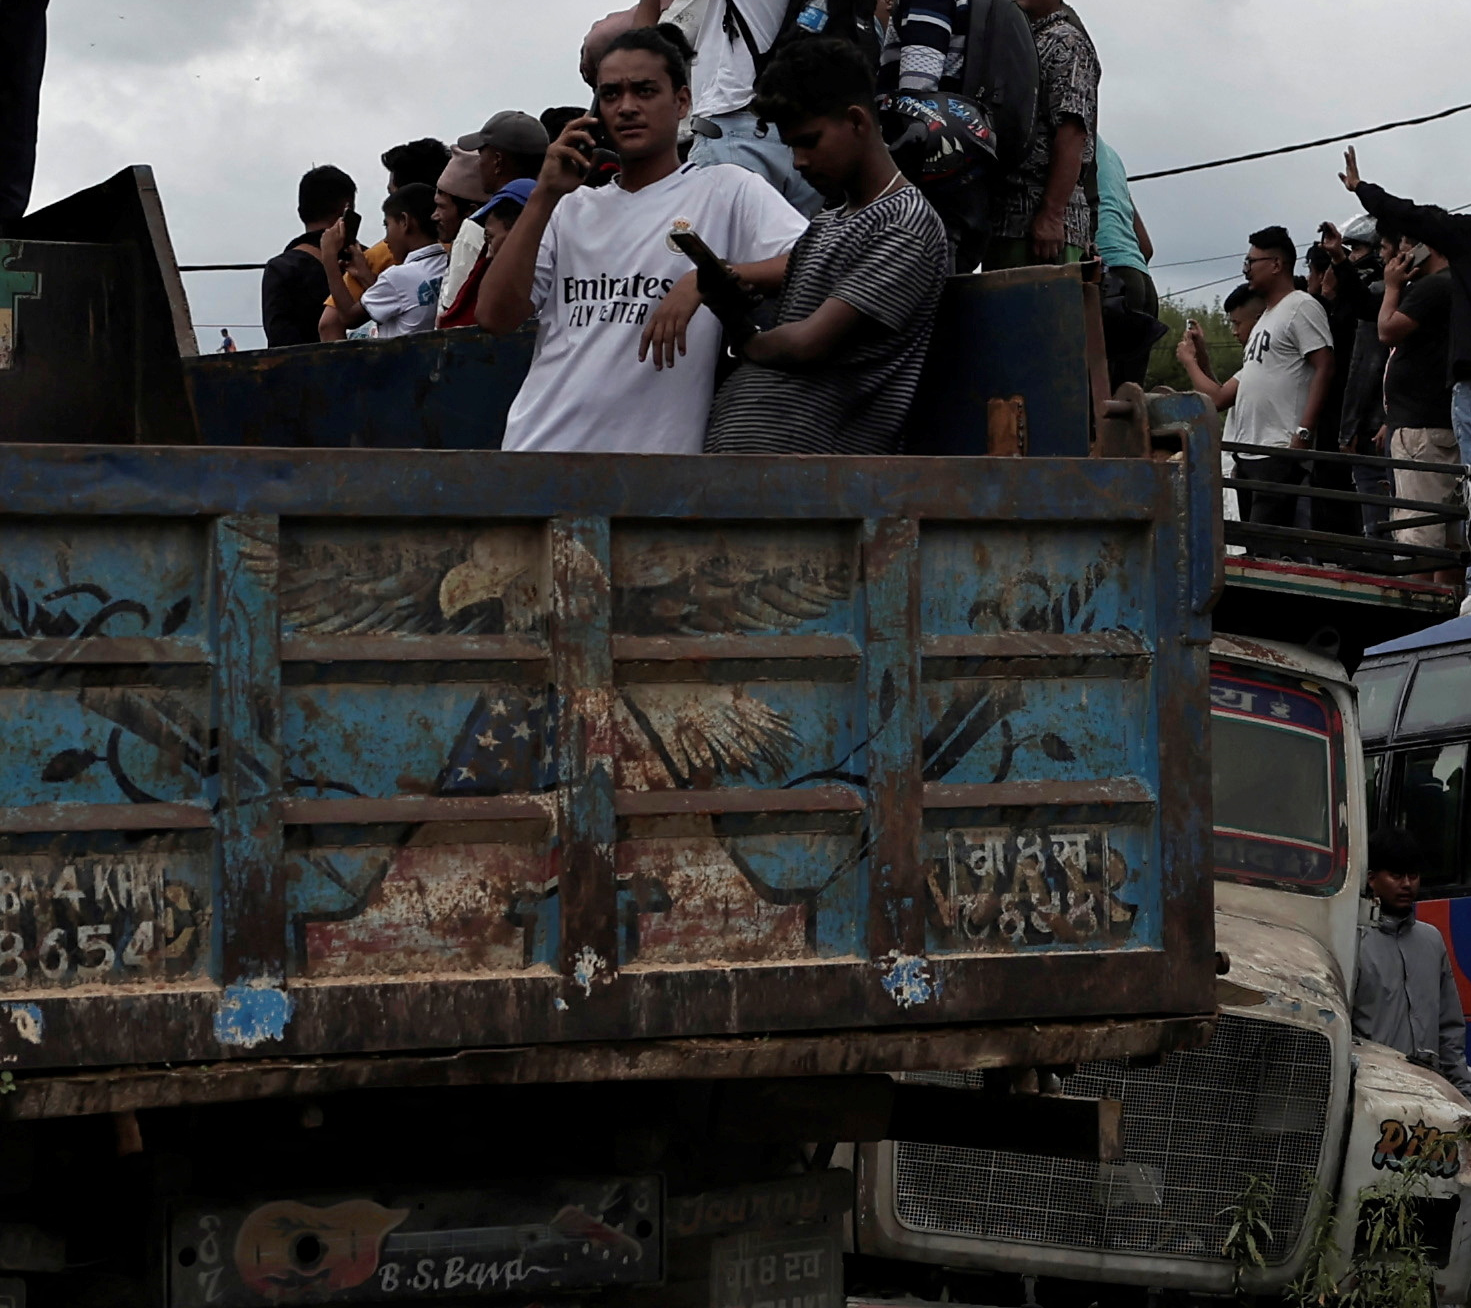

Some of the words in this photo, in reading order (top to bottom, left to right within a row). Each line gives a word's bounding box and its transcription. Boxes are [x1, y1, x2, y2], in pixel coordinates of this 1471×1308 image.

[563, 272, 674, 303] Emirates
[569, 305, 594, 327] FLY
[1243, 329, 1270, 364] AP
[52, 865, 86, 910] 4
[93, 863, 156, 913] KHA
